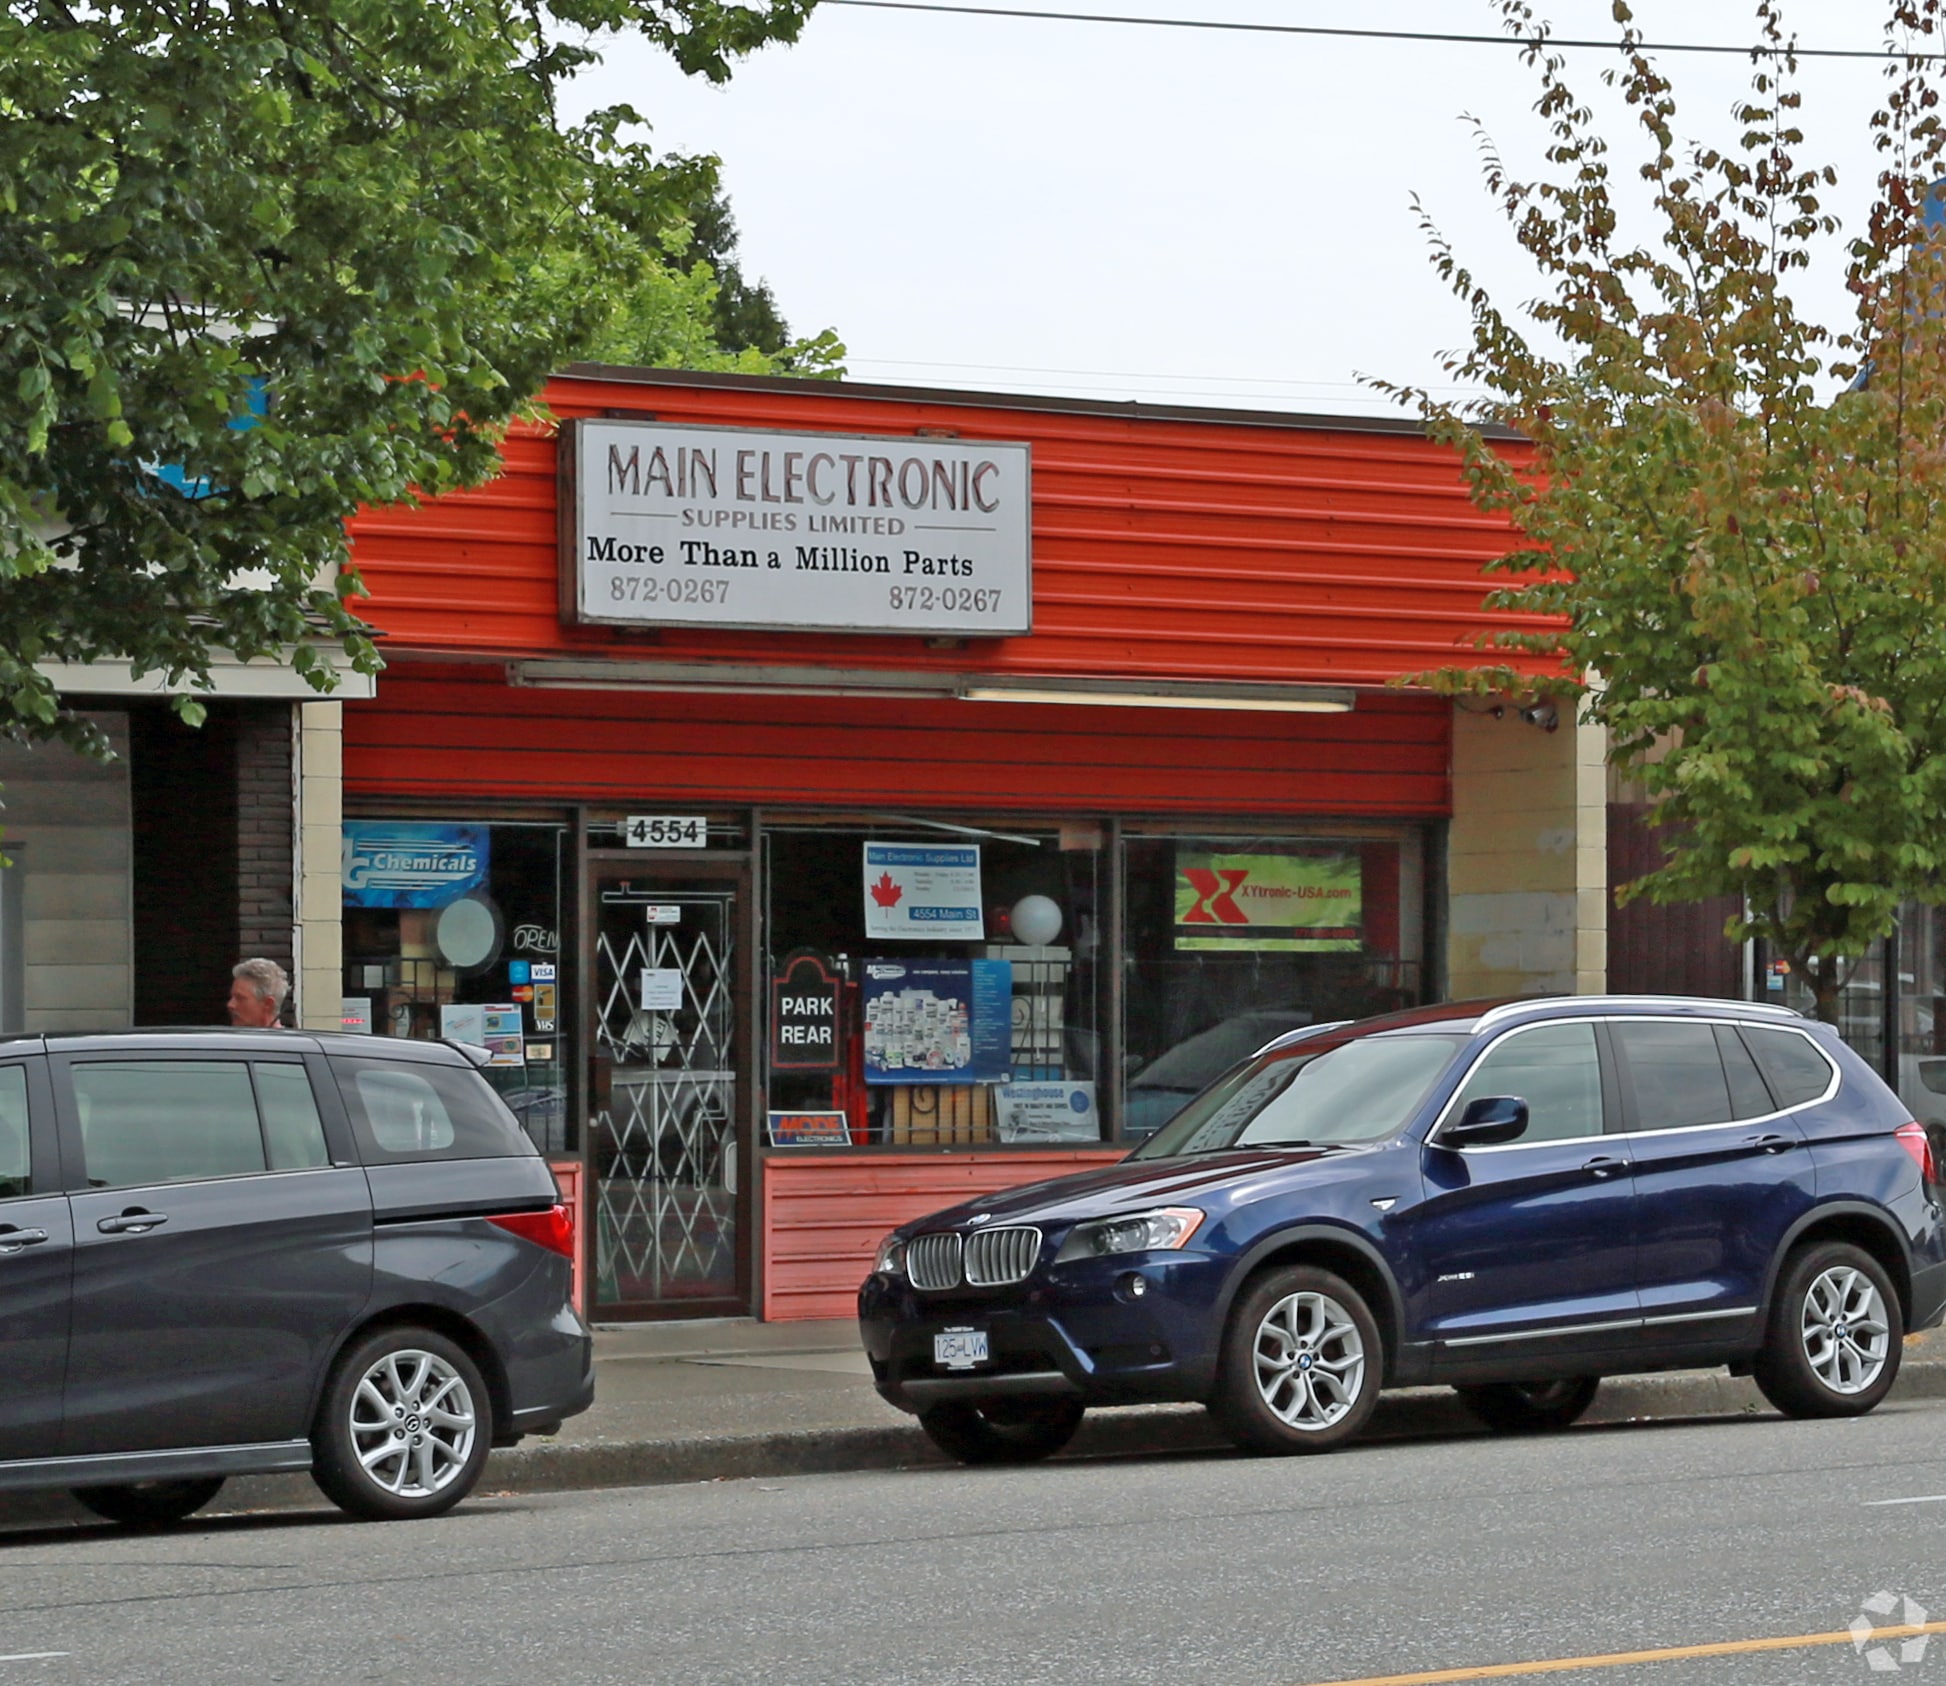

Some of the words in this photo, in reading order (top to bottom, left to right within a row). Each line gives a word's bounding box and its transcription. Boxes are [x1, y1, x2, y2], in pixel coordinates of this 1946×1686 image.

[608, 444, 717, 498] MAIN
[736, 449, 1000, 513] ELECTRONIC
[682, 508, 797, 532] SUPPLIES
[808, 515, 905, 536] LIMITED
[587, 536, 665, 564] More
[680, 541, 759, 568] Than
[767, 553, 781, 569] a
[795, 546, 891, 573] Million
[902, 550, 973, 576] Parts
[611, 577, 730, 603] 872-0267
[889, 586, 1002, 612] 872-0267
[632, 820, 697, 843] 4554
[373, 853, 477, 871] Chemicals
[868, 851, 885, 861] Main
[887, 852, 924, 862] Electronic
[925, 853, 959, 864] Supplies
[961, 854, 974, 863] Ltd
[1241, 885, 1352, 899] XYtronic-USA.com
[913, 908, 937, 919] 4554
[939, 908, 964, 919] Main
[965, 909, 977, 920] St
[514, 927, 560, 951] OPEN
[533, 967, 554, 977] VISA
[781, 997, 833, 1016] PARK
[781, 1025, 832, 1044] REAR
[777, 1116, 842, 1138] MODE
